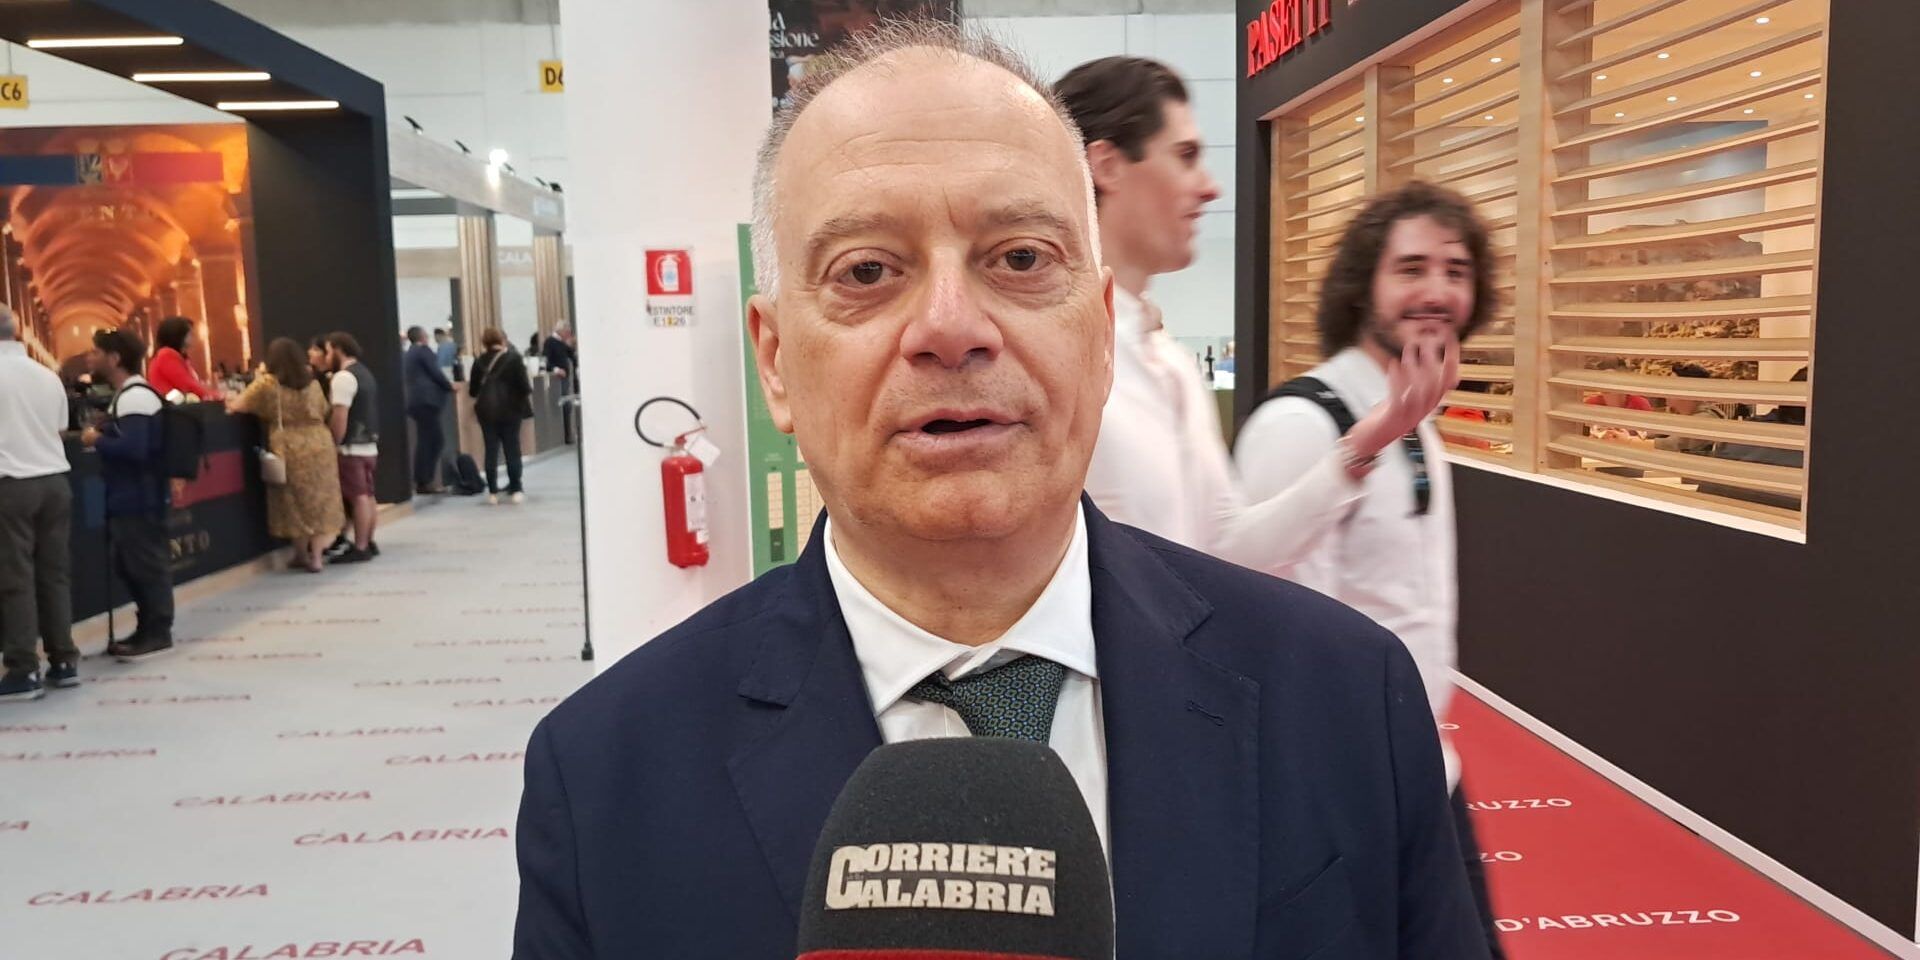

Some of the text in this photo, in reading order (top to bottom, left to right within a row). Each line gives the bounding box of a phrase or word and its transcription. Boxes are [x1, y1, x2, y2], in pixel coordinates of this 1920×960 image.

[1, 82, 22, 101] C6
[173, 789, 372, 807] CALABRIA
[293, 826, 509, 846] CALABRIA
[830, 842, 1056, 880] CORRIERE
[28, 883, 268, 906] CALABRIA
[825, 876, 1055, 917] CALABRIA
[1493, 908, 1741, 933] D'ABRUZZO
[159, 937, 426, 960] CALABRIA
